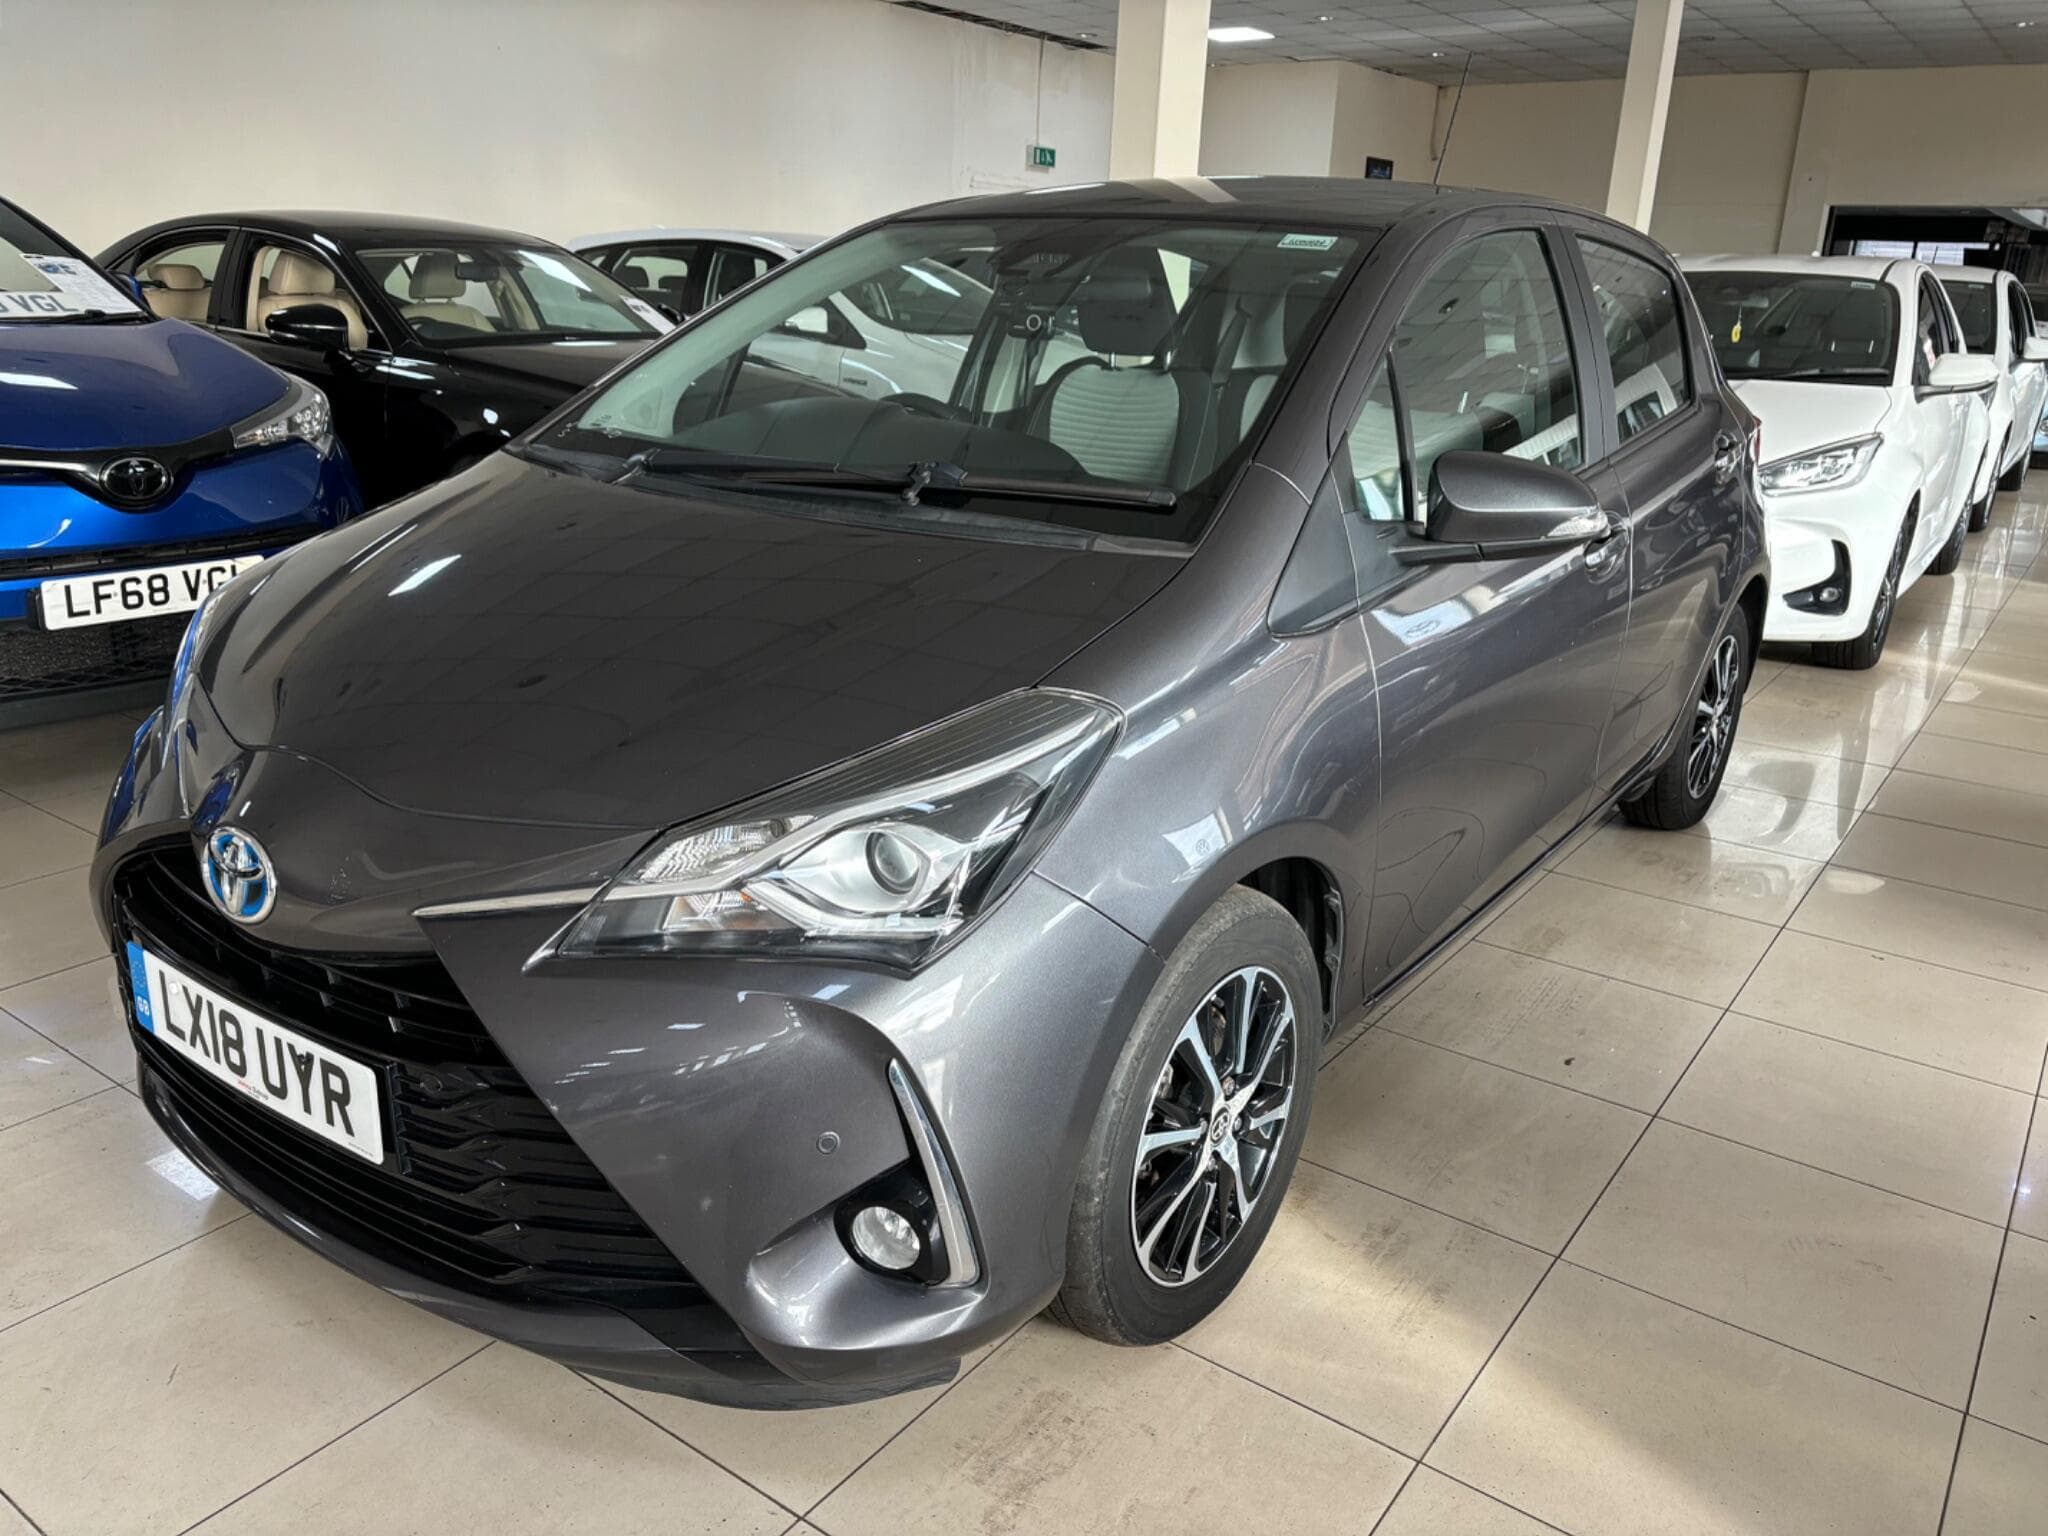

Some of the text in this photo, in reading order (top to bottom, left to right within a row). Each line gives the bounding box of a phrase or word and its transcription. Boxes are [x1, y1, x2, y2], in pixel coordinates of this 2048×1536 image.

[7, 294, 79, 312] VGL
[64, 573, 171, 618] LF68
[159, 970, 355, 1137] LX18 UYR
